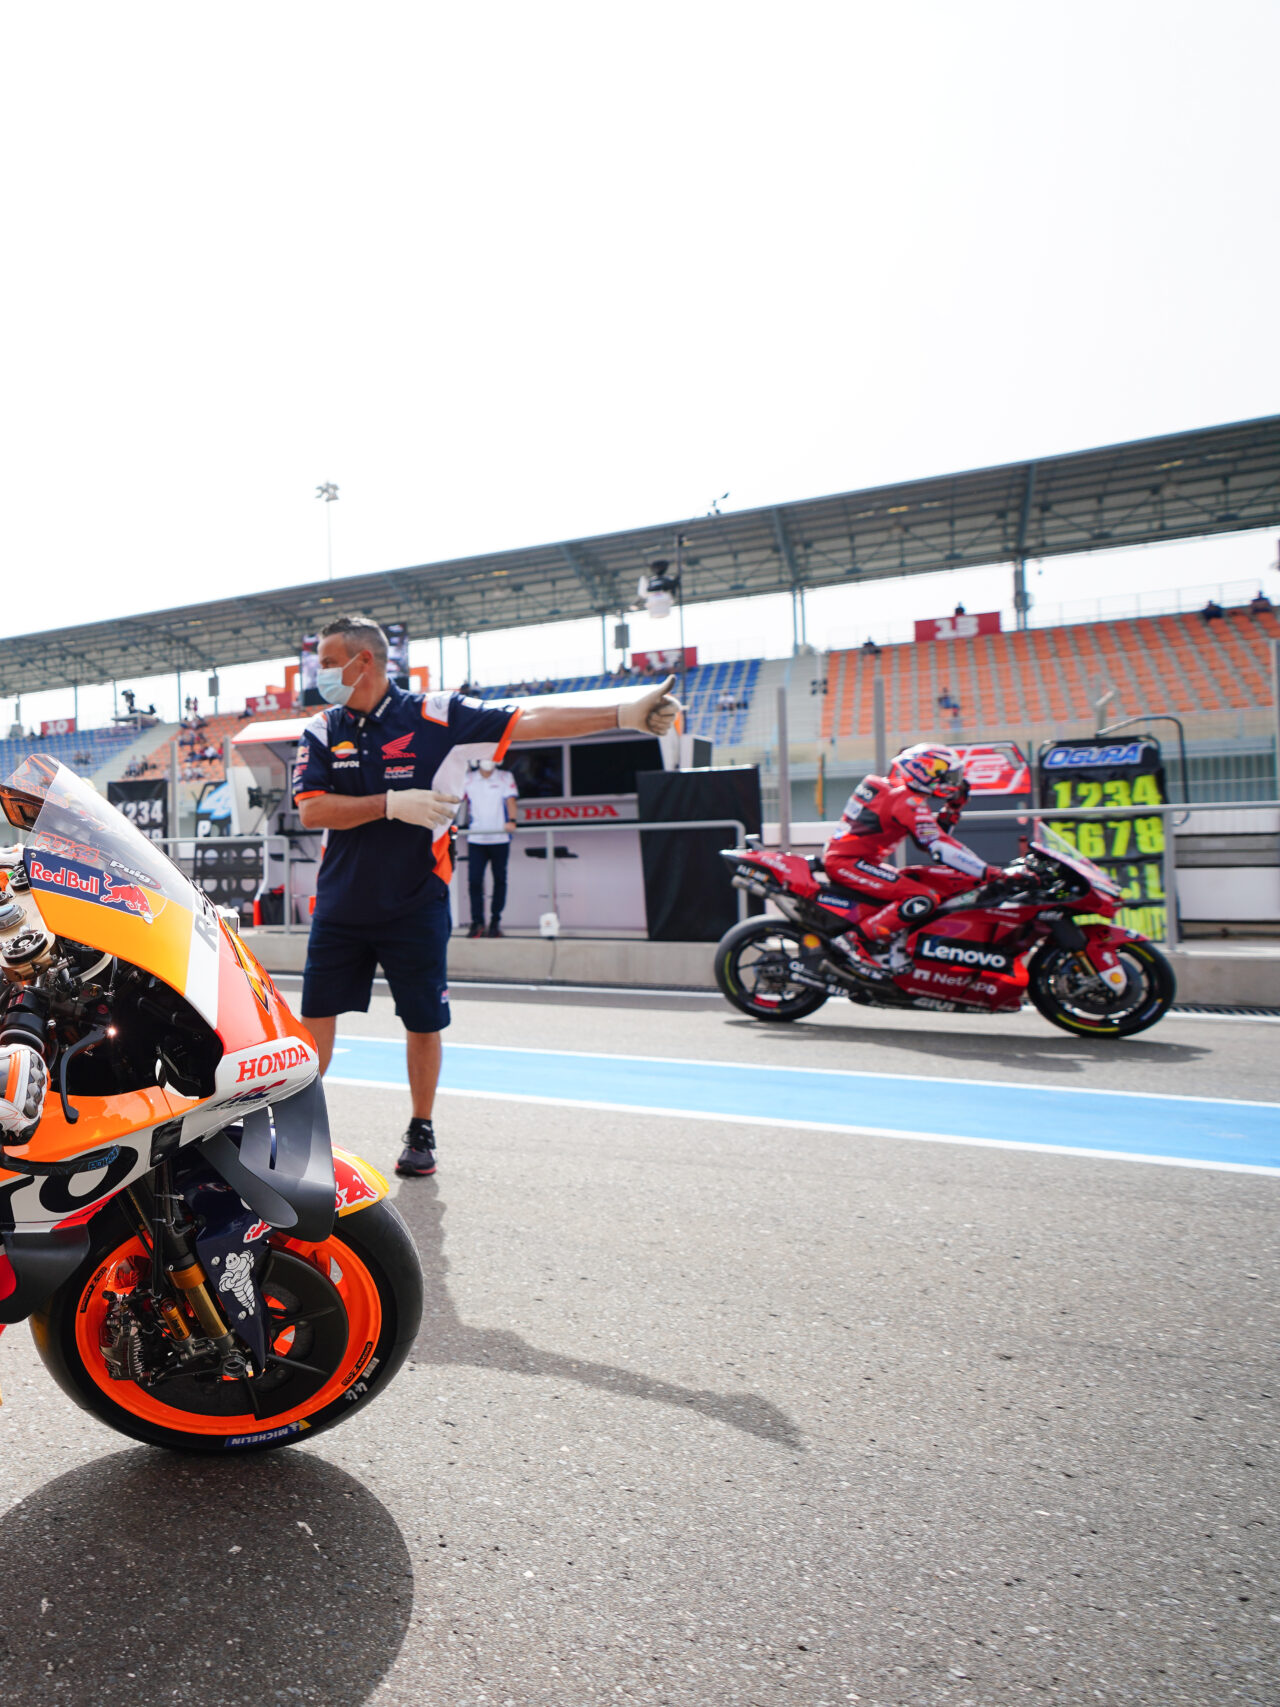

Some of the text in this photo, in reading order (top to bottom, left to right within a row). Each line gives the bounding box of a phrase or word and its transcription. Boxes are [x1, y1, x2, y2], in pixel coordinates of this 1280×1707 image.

[936, 616, 979, 639] 13
[256, 695, 280, 712] 11
[47, 720, 69, 734] 10
[1043, 743, 1144, 768] OGURA
[1054, 774, 1163, 808] 1234
[524, 805, 619, 820] HONDA
[110, 859, 152, 884] Puig
[922, 940, 1006, 968] Lenovo
[235, 1044, 311, 1083] HONDA
[231, 1429, 289, 1445] MICHELIN
